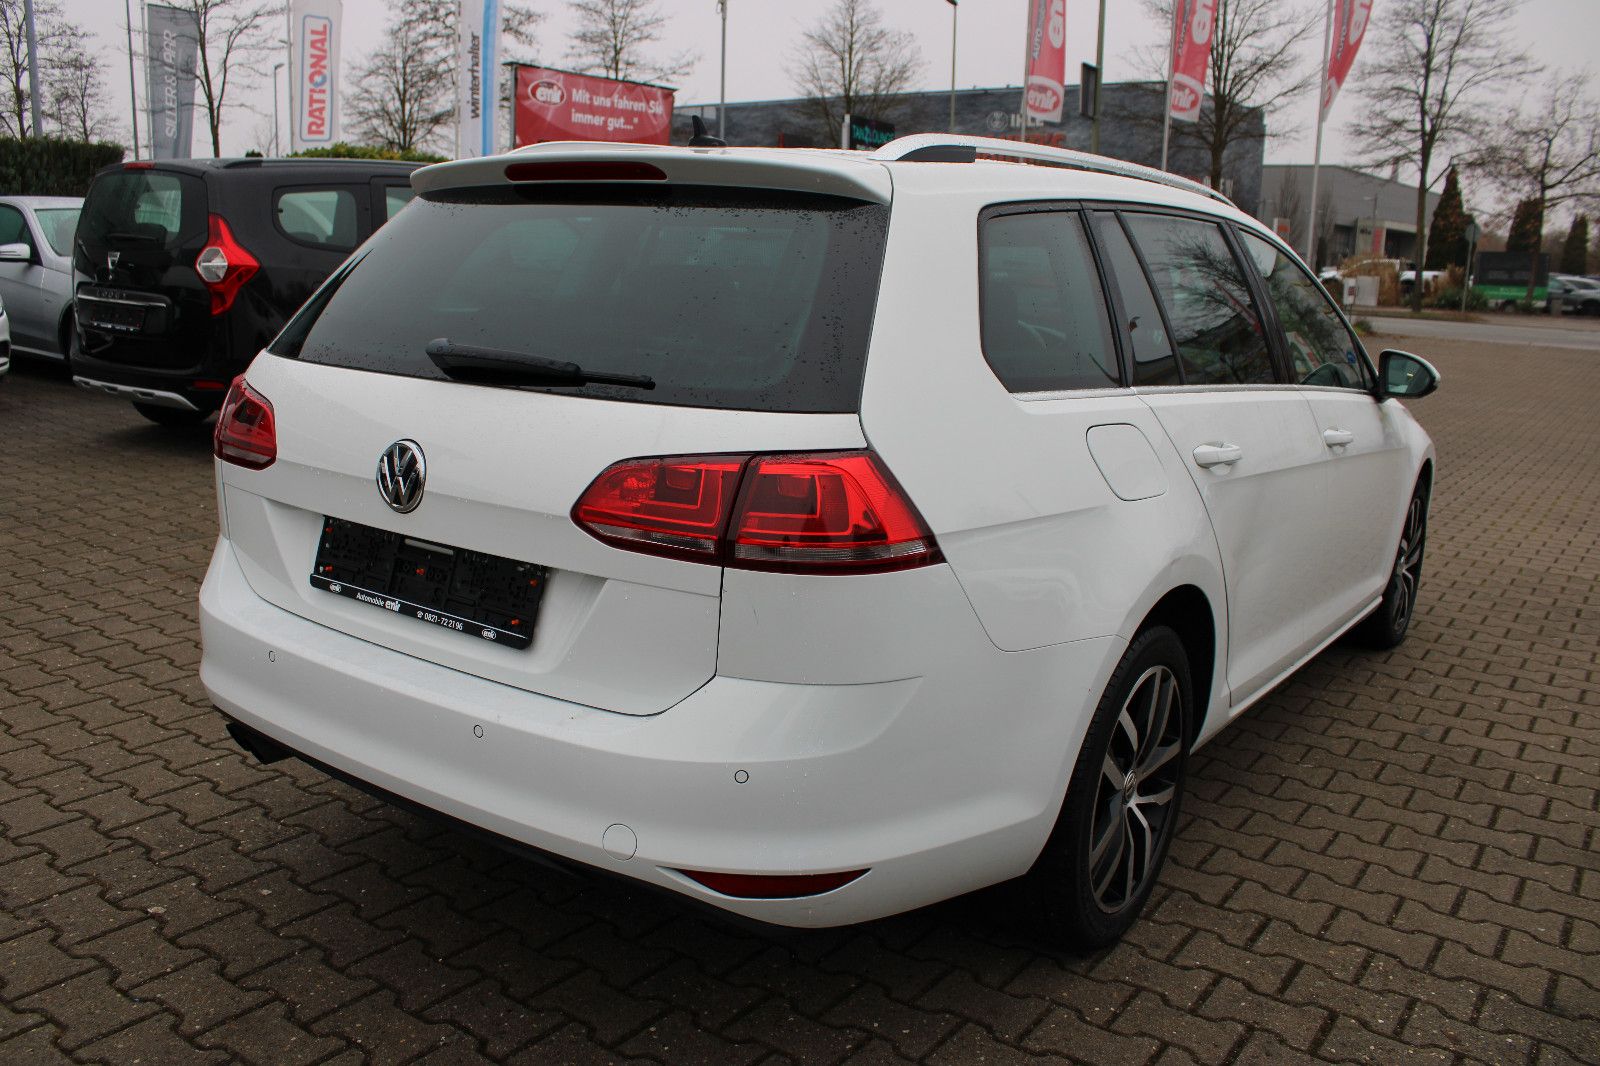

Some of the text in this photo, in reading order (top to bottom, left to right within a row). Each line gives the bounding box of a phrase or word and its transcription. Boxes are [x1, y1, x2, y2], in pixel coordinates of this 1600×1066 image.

[308, 24, 328, 136] RATIONAL
[467, 32, 480, 119] winterhalter
[536, 84, 561, 104] emir
[571, 88, 664, 114] Mit uns fahren Sie
[1170, 88, 1195, 109] mir
[571, 109, 605, 126] immer
[356, 592, 400, 612] Automobile emir
